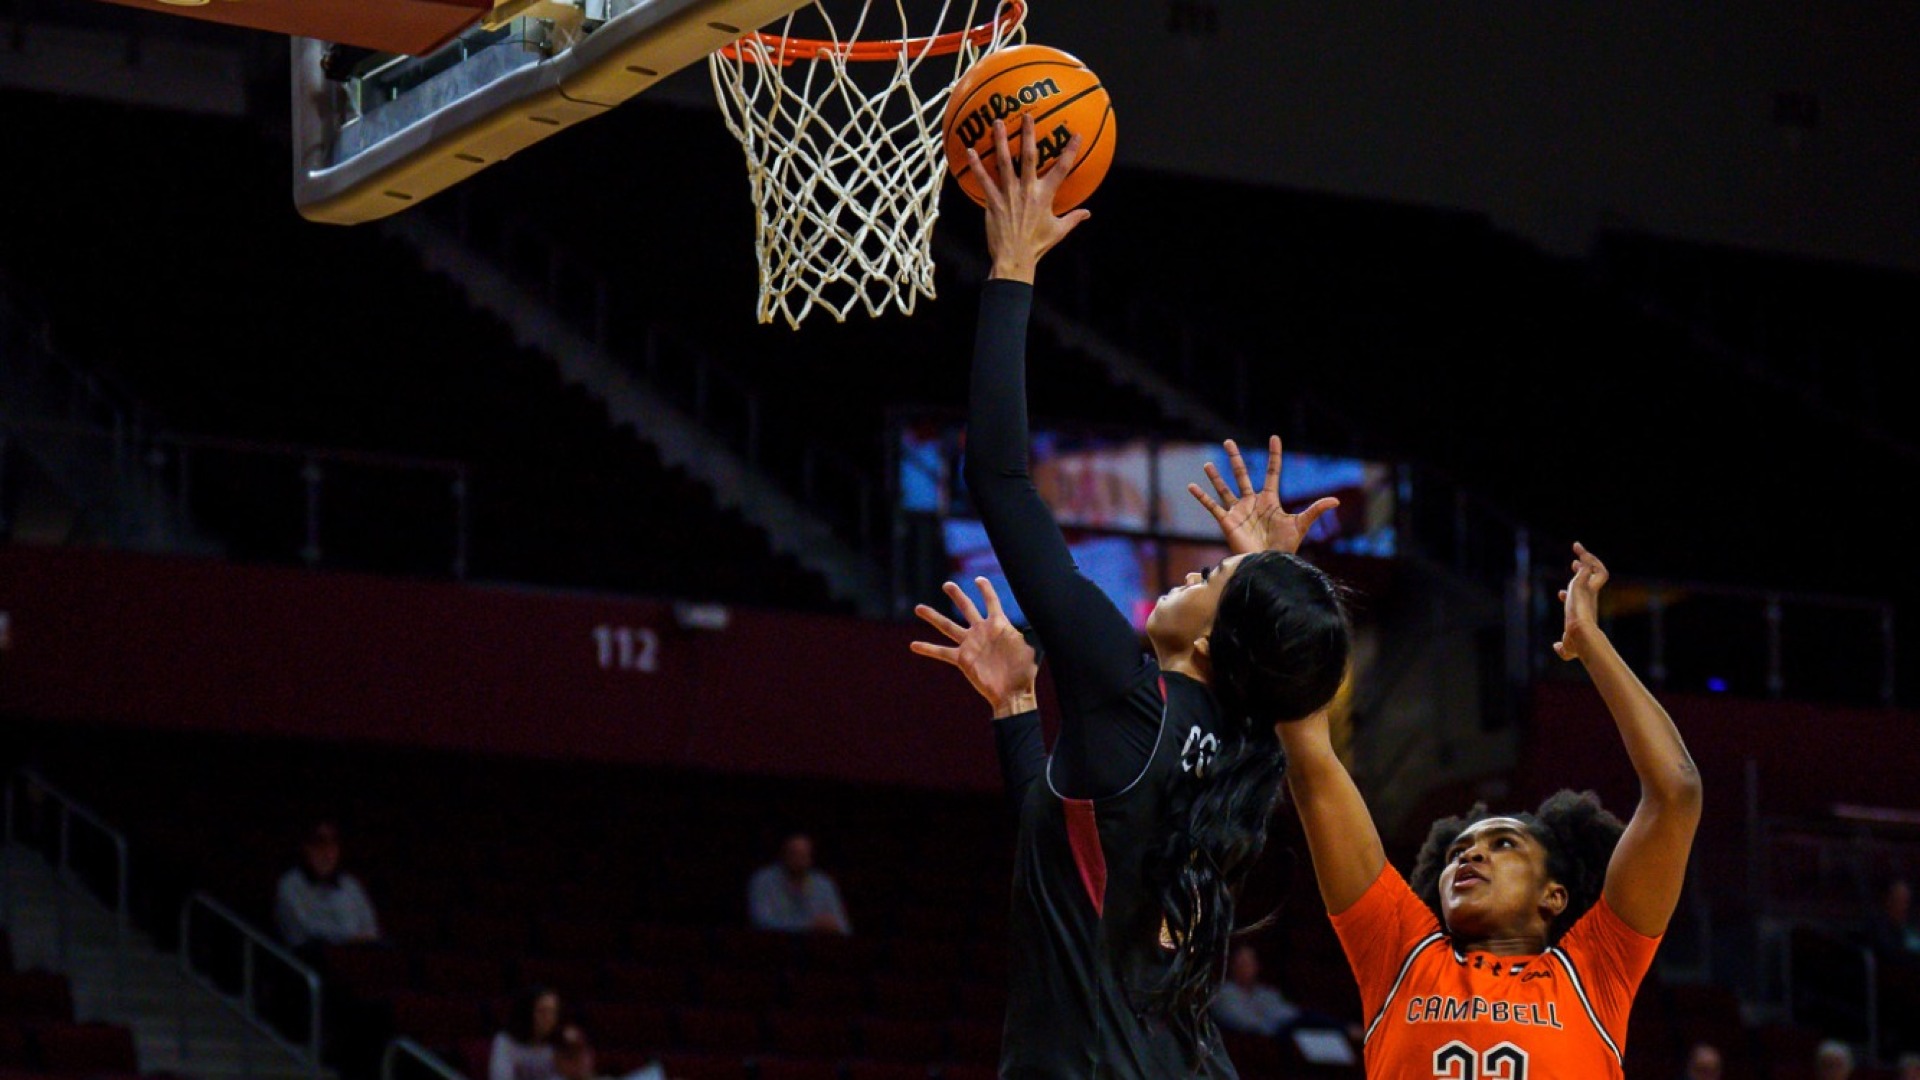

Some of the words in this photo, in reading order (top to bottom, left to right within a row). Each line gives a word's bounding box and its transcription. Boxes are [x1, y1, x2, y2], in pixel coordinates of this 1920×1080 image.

[955, 77, 1061, 149] Wilson
[592, 625, 658, 672] 112
[1406, 996, 1563, 1030] CAMPBELL
